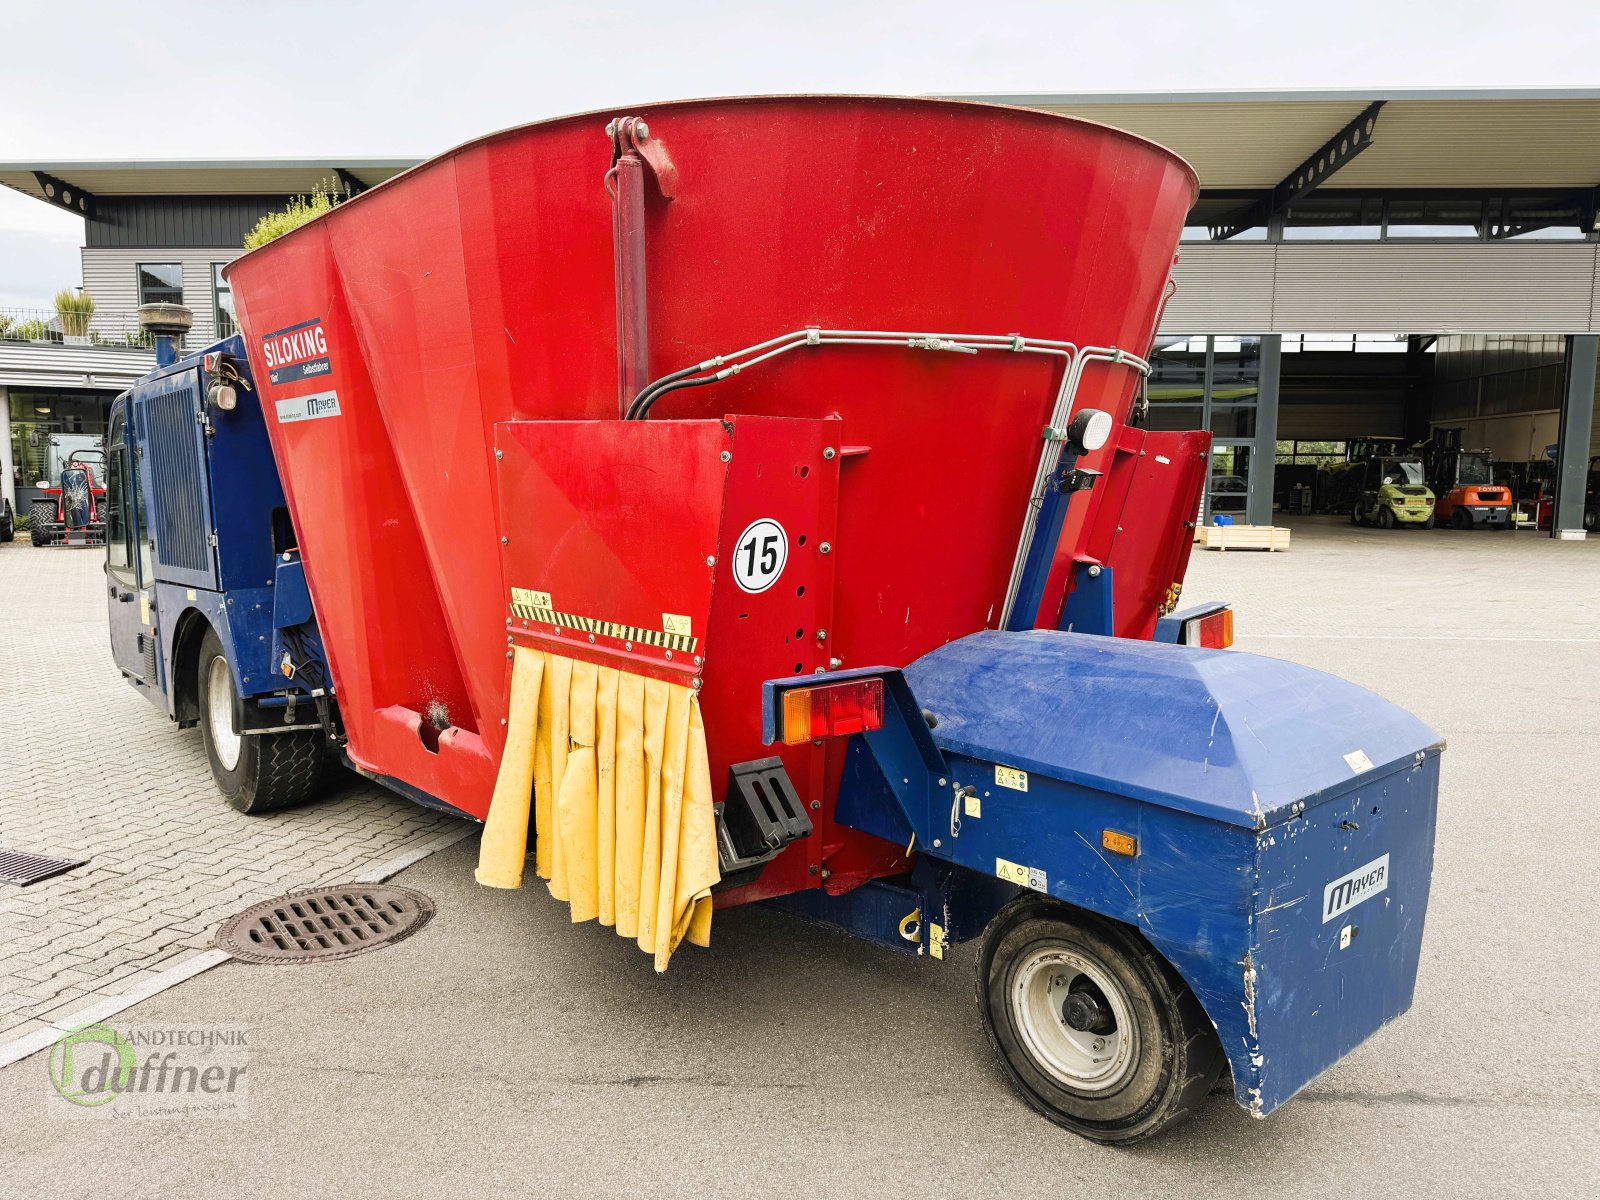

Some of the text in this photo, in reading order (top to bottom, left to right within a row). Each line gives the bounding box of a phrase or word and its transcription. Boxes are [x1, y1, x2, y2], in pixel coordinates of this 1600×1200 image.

[263, 326, 328, 368] SILOKING
[307, 398, 337, 416] MAYER
[743, 535, 778, 577] 15
[1327, 866, 1385, 915] MAYER
